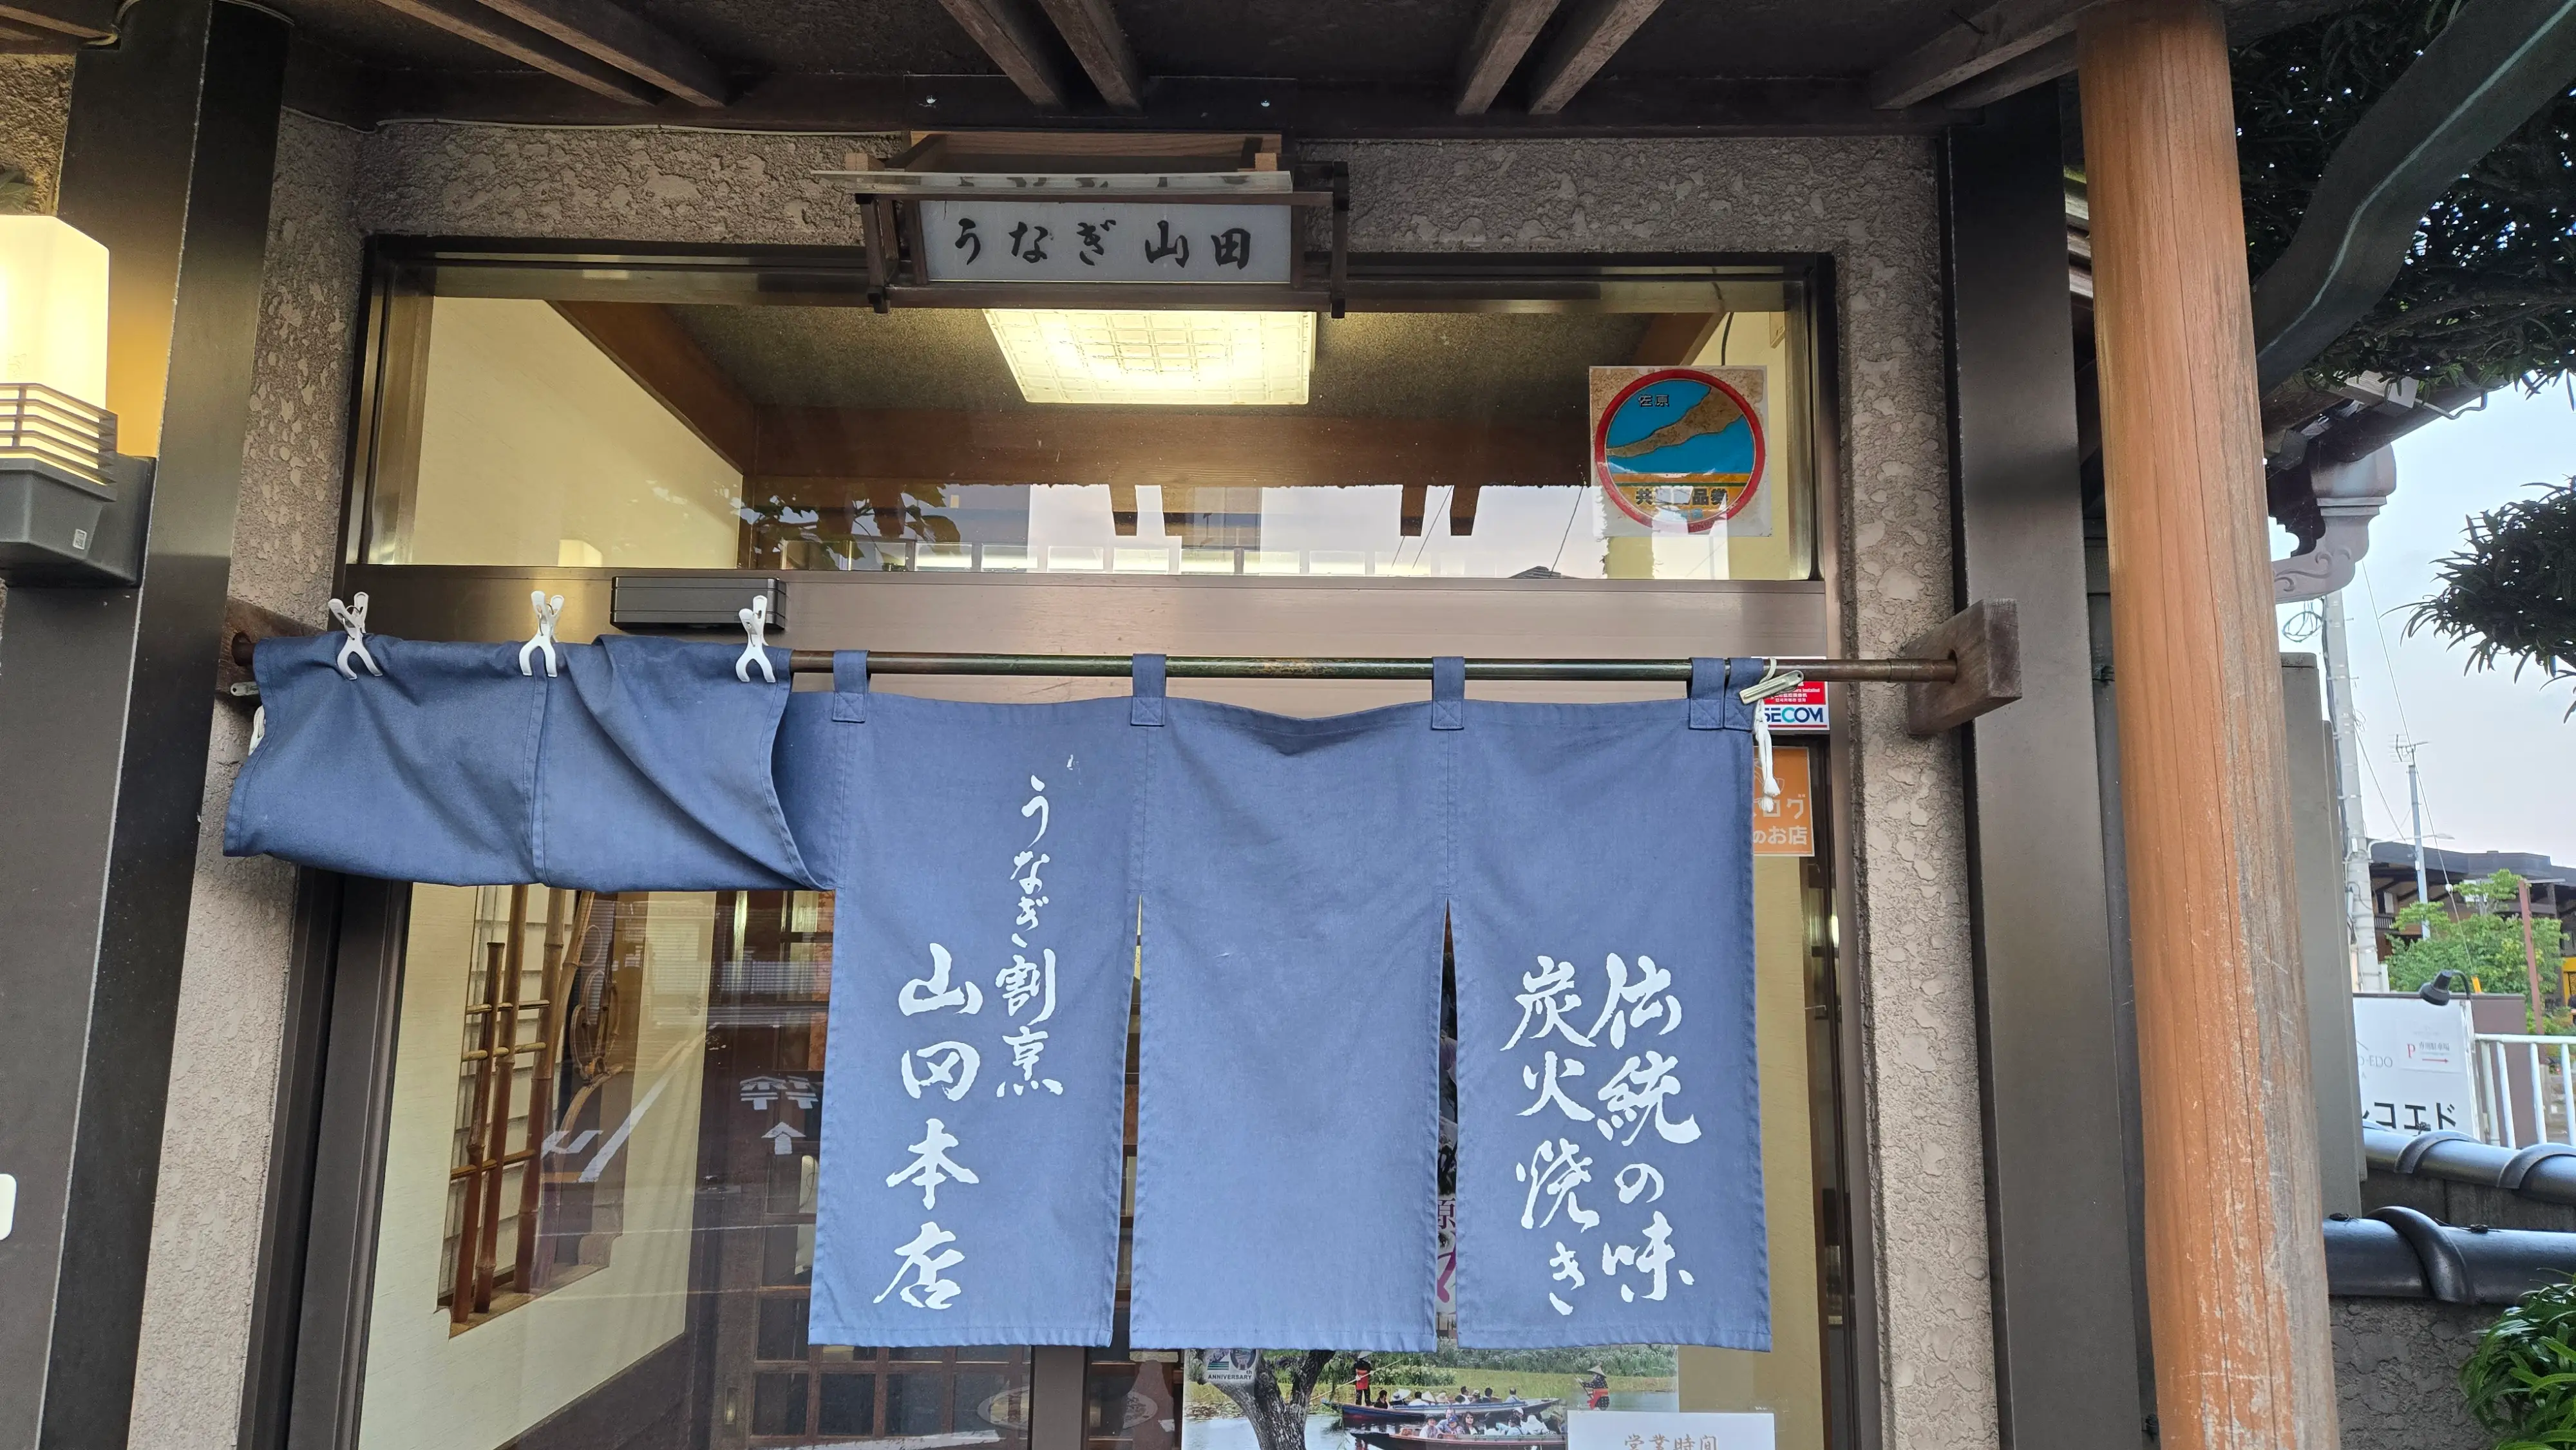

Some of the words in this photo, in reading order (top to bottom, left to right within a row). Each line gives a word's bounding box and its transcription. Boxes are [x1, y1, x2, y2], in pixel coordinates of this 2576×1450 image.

[955, 218, 1251, 270] うなぎ山田
[1638, 394, 1669, 407] 佐原
[1636, 487, 1728, 505] 共品券
[1765, 707, 1823, 722] SECOM
[995, 775, 1063, 1097] うなぎ割烹
[873, 943, 983, 1310] 山田本店
[1501, 956, 1600, 1315] 炭火焼き
[1587, 953, 1702, 1303] 伝統の味
